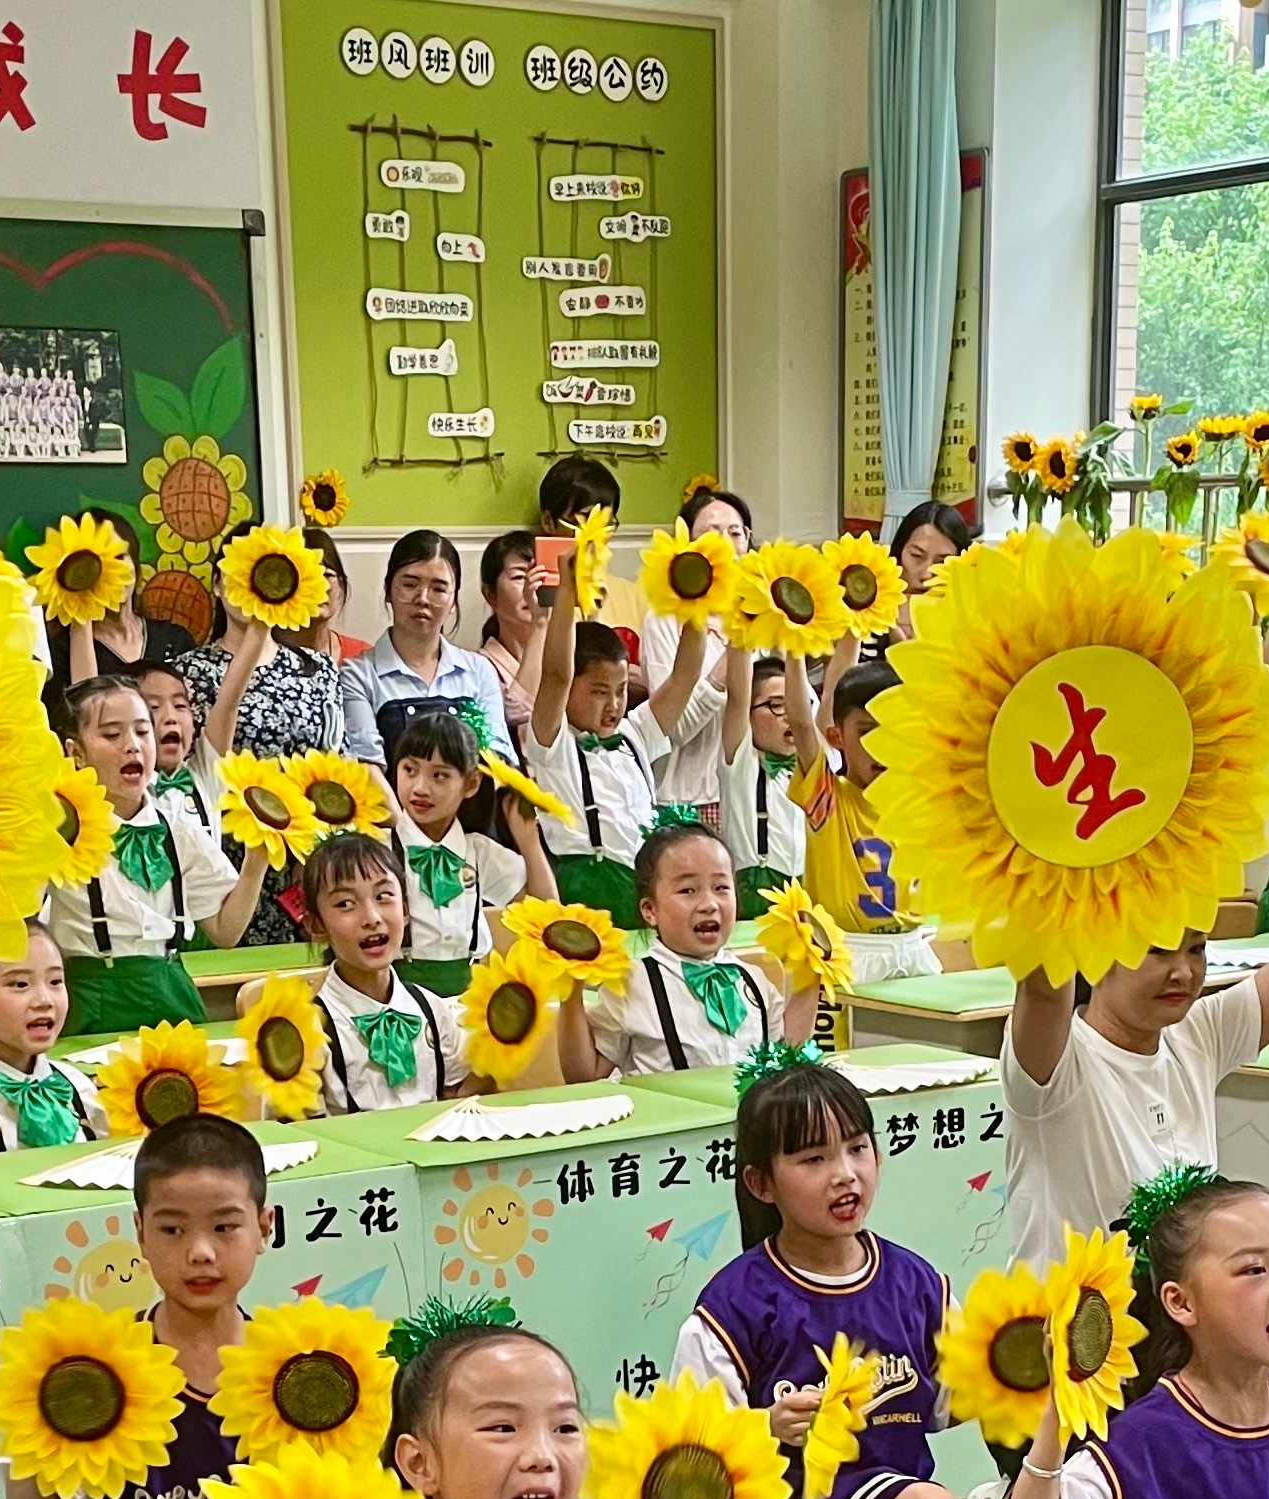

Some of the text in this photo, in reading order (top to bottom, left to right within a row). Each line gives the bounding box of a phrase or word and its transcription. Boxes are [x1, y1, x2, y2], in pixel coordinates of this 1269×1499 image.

[347, 38, 490, 78] 班风班训
[531, 55, 666, 95] 班级公约
[441, 239, 464, 255] 向上
[431, 416, 478, 433] 快乐生长
[1030, 681, 1147, 842] 生
[855, 837, 897, 918] 3
[885, 1102, 1005, 1157] 梦想之
[556, 1137, 737, 1205] 体育之花
[271, 1186, 399, 1249] 之花
[616, 1353, 661, 1400] 快
